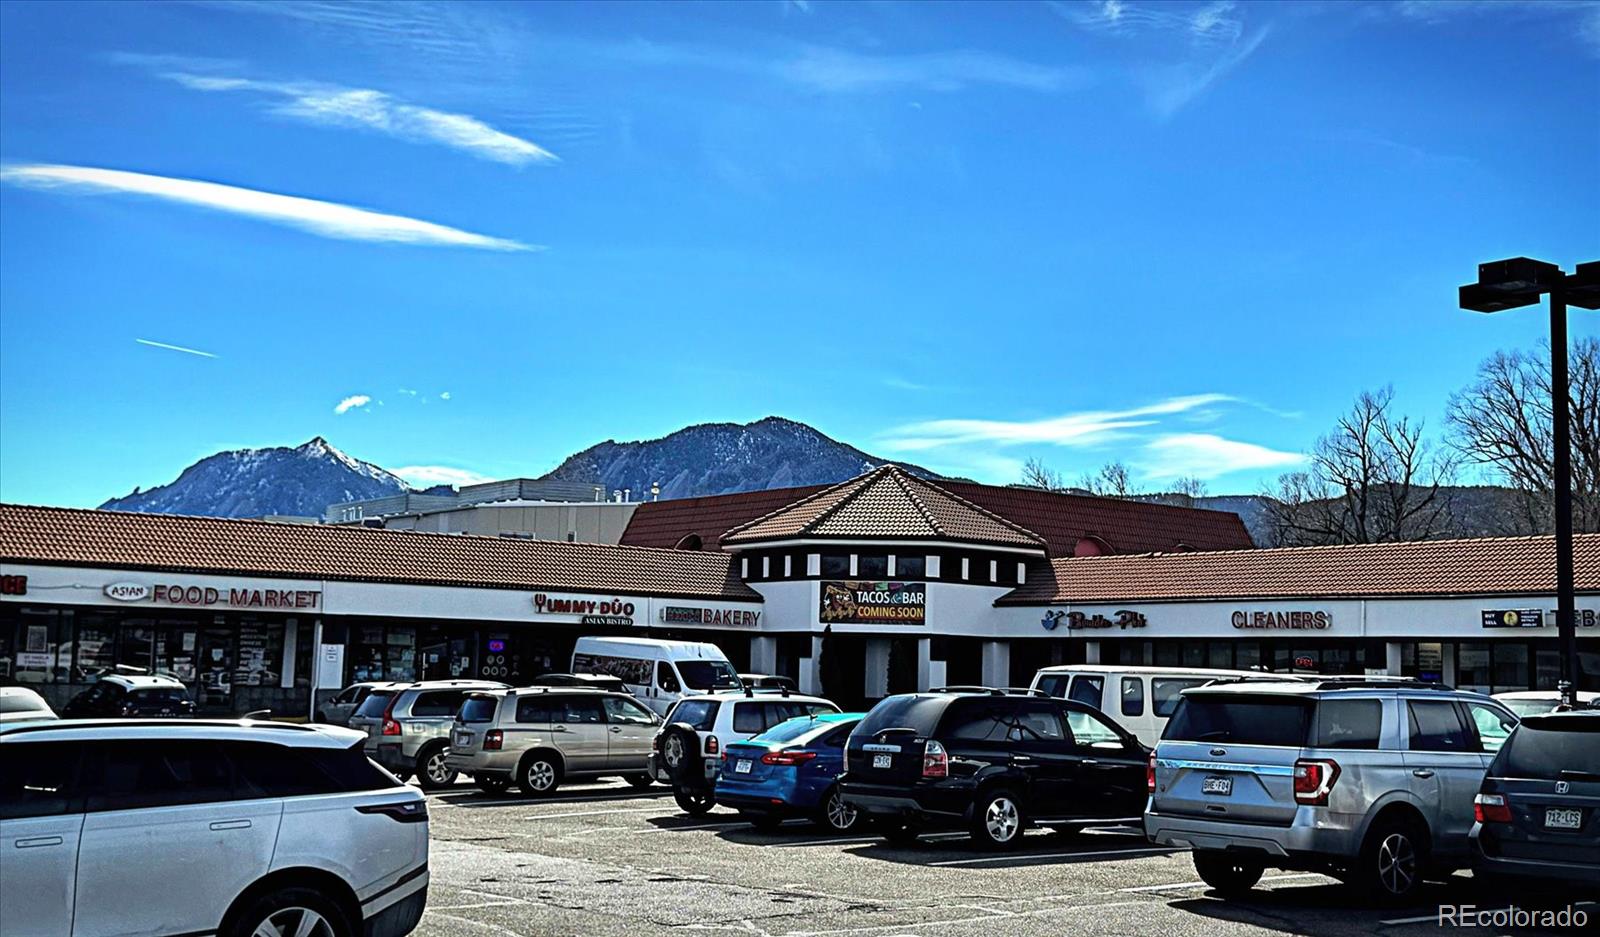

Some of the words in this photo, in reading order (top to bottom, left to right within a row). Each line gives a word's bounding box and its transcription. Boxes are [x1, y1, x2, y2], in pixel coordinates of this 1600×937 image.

[0, 575, 27, 595] CE
[111, 586, 144, 597] ASIAN
[153, 585, 219, 605] FOOD
[229, 588, 321, 608] MARKET
[535, 593, 597, 613] YUMMY
[856, 591, 890, 604] TACOS
[903, 592, 924, 604] BAR
[584, 617, 604, 625] ASIAN
[606, 618, 632, 626] BISTRO
[703, 608, 761, 627] BAKERY
[857, 606, 896, 617] COMING
[897, 607, 924, 618] SOON
[1231, 610, 1328, 630] CLEANERS
